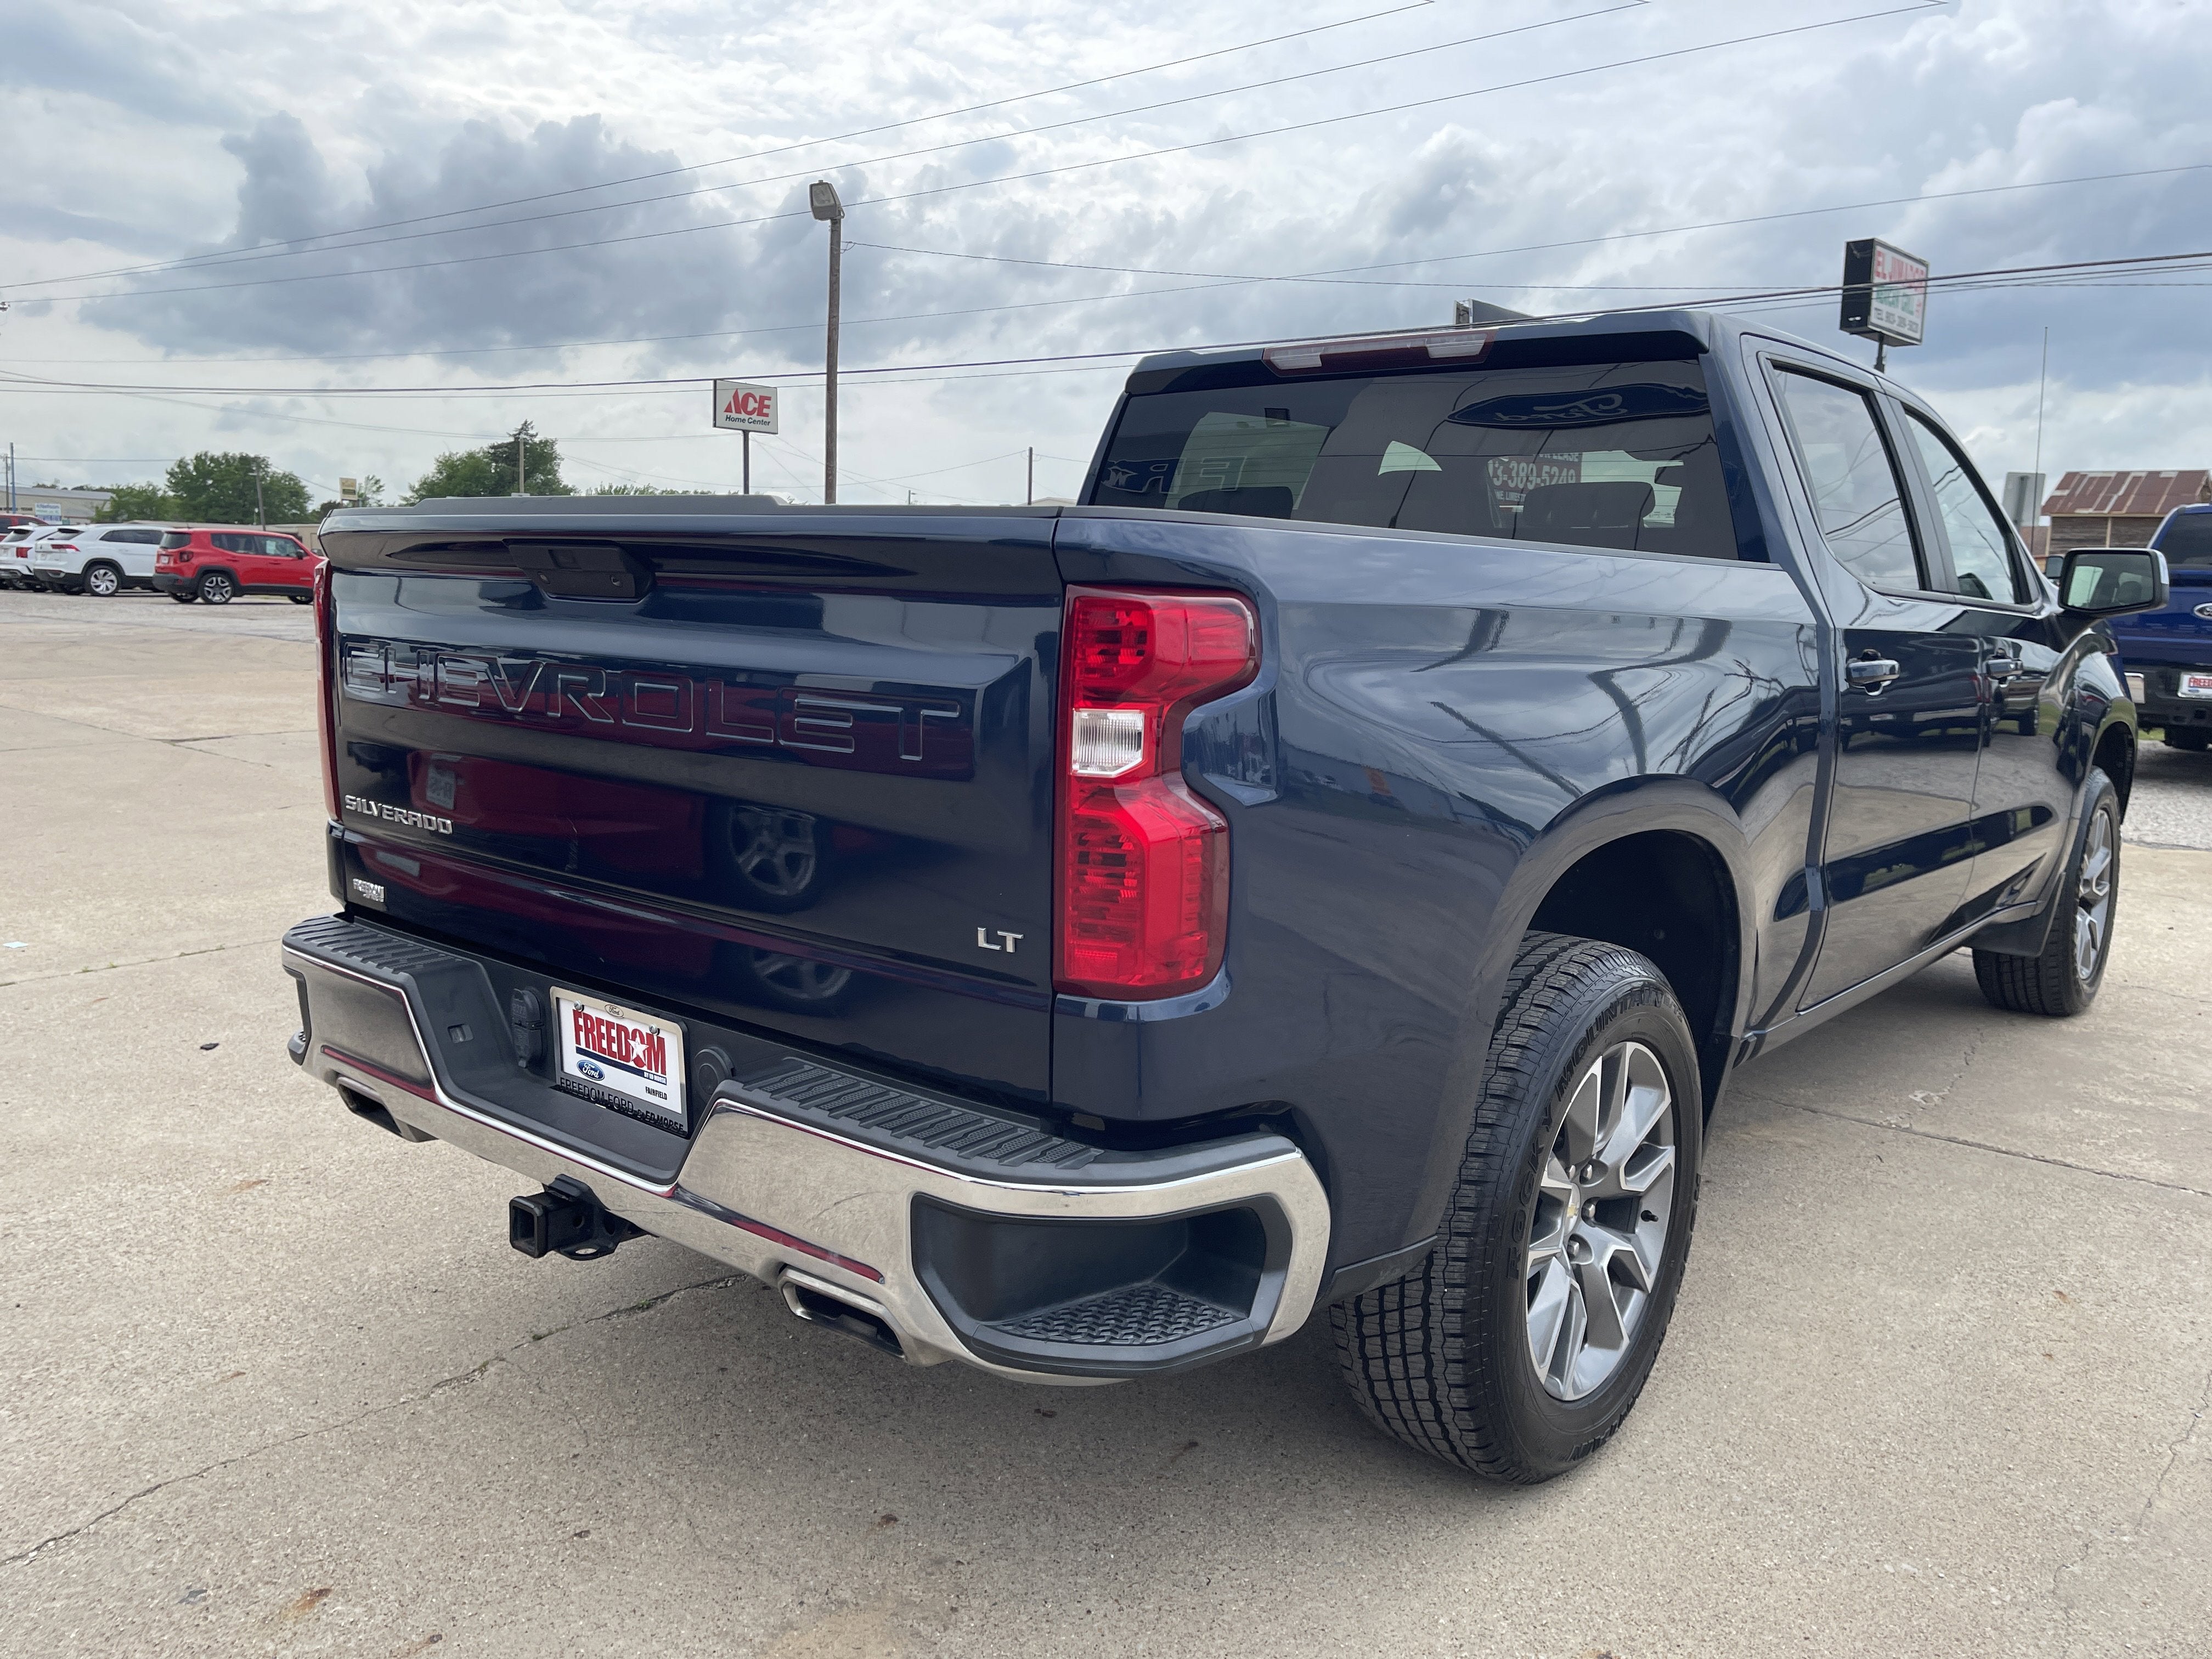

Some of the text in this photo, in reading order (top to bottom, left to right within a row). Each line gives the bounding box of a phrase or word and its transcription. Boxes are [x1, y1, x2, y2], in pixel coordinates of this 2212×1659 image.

[724, 388, 772, 417] ACE
[725, 415, 771, 426] Home Center
[343, 642, 960, 761] CHEVROLET
[345, 795, 453, 835] SILVERADO
[978, 927, 1024, 953] LT
[573, 1008, 667, 1075] FREEDOM
[1554, 986, 1664, 1102] MOUNTAIN
[582, 1062, 600, 1079] Ford
[560, 1077, 605, 1104] FREEDOM
[608, 1093, 634, 1114] FORD
[645, 1086, 667, 1100] FAIRFIELD
